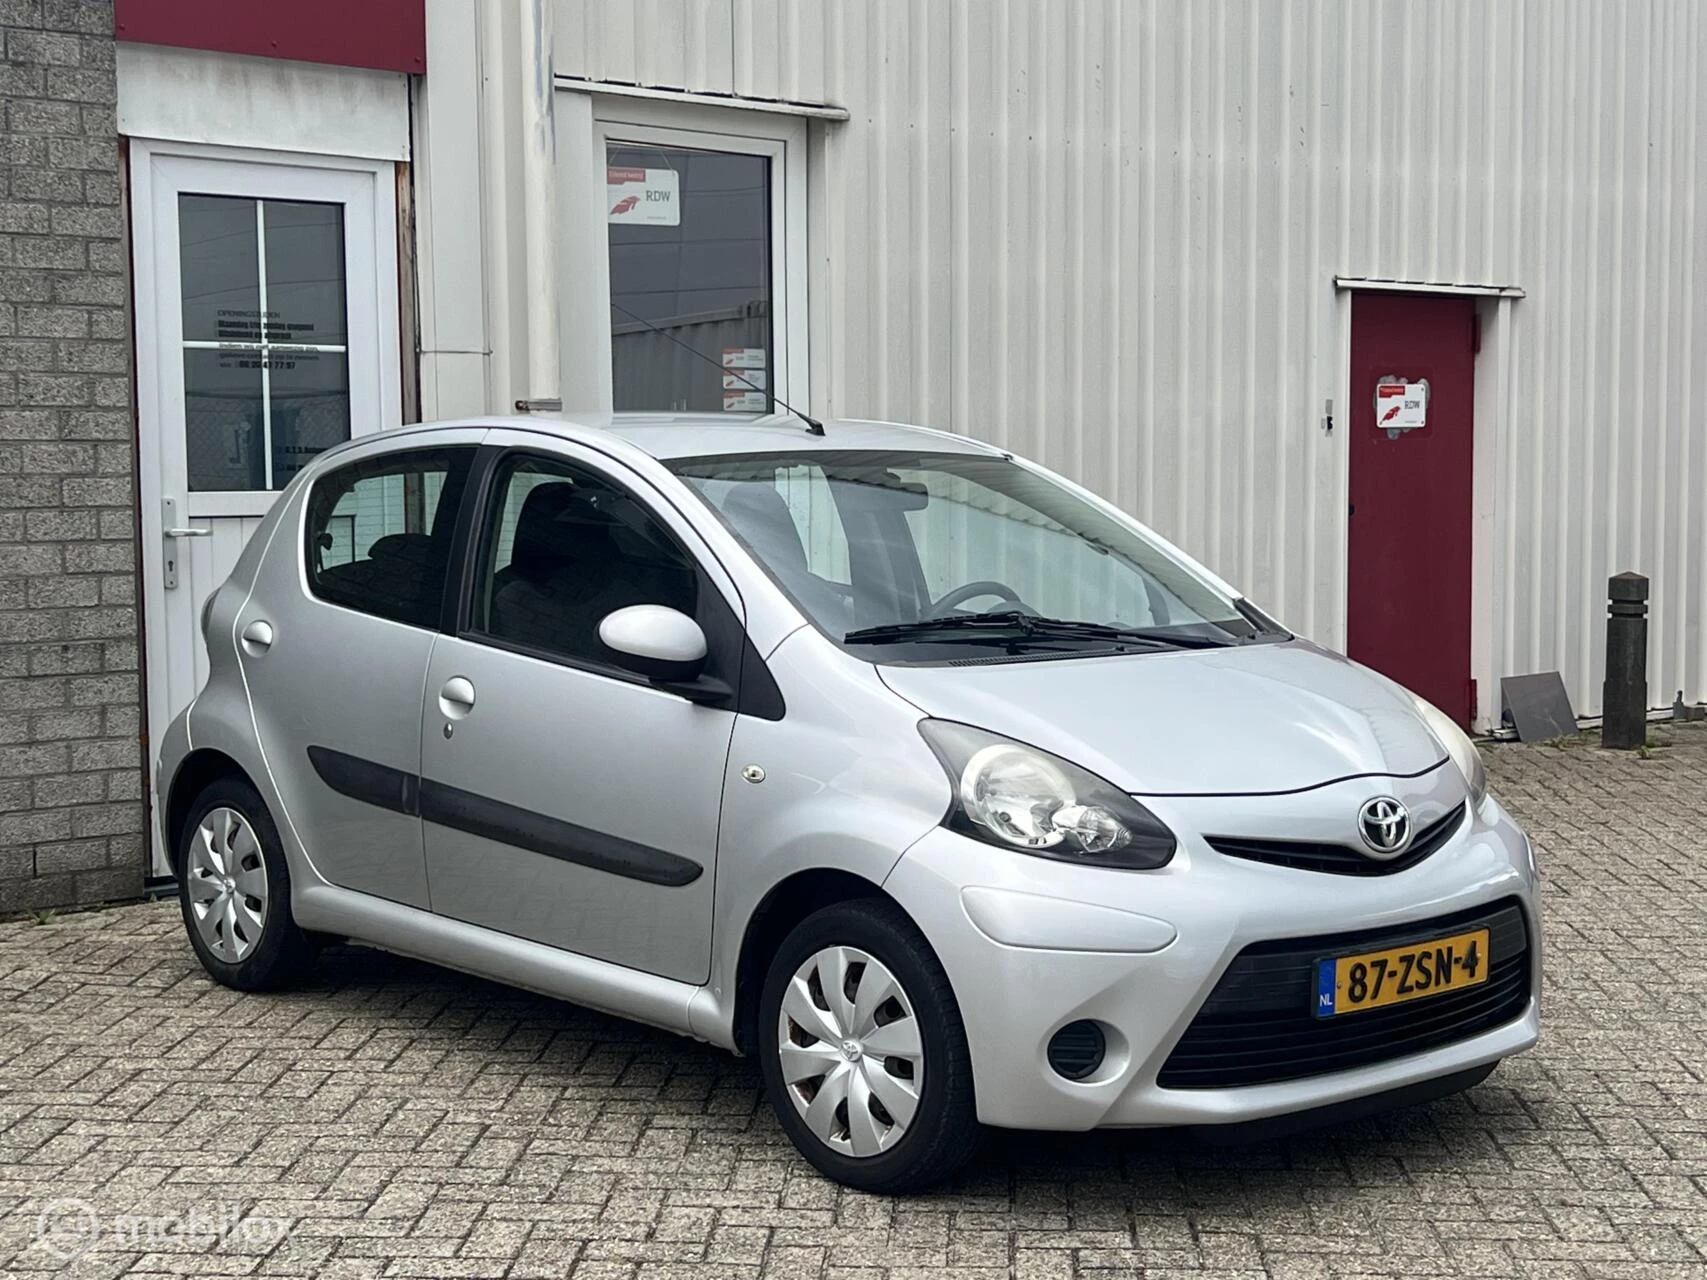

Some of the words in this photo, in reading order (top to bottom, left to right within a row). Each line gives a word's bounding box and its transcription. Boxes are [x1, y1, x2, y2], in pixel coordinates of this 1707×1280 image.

[646, 190, 671, 202] RDW
[1348, 940, 1479, 1003] 87-ZSN-4
[1320, 994, 1333, 1007] NL
